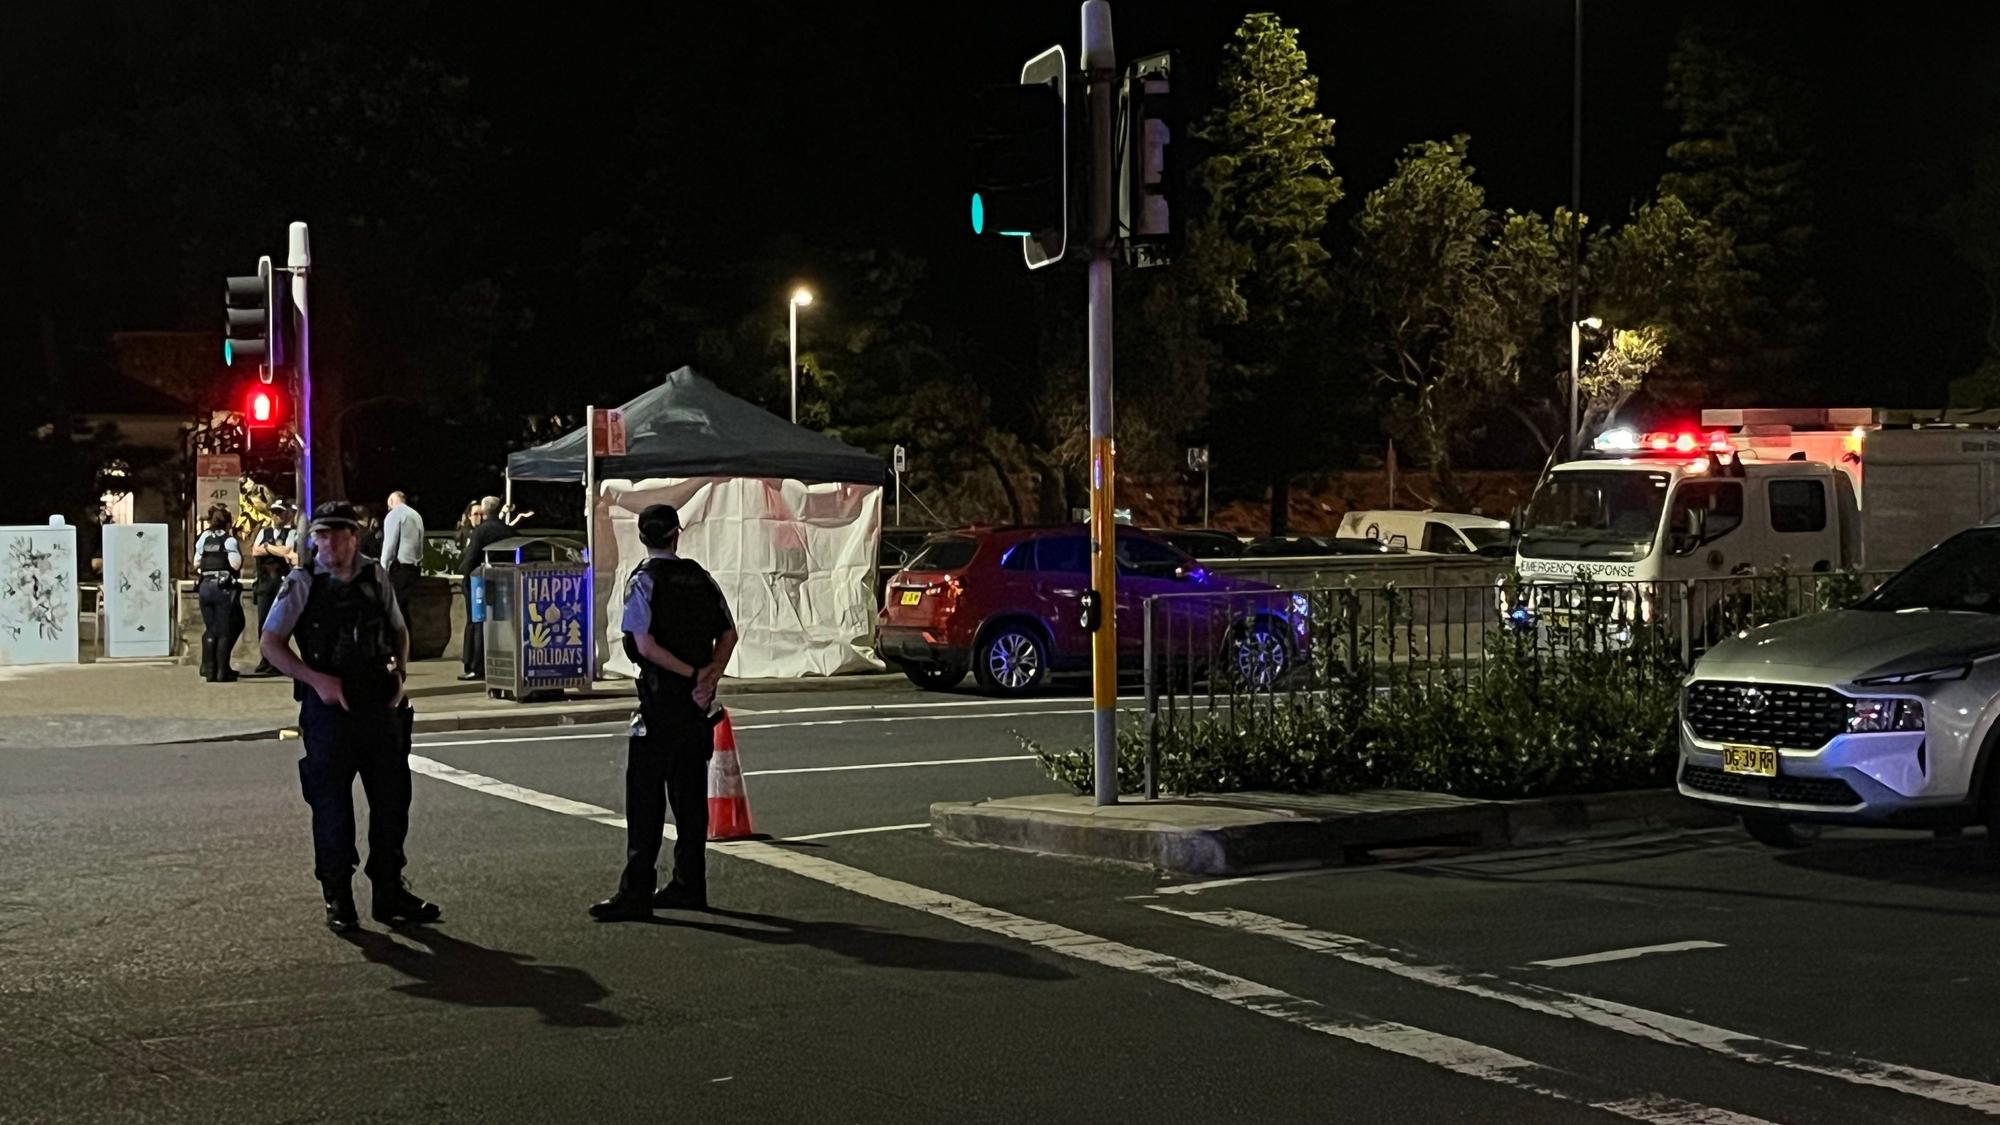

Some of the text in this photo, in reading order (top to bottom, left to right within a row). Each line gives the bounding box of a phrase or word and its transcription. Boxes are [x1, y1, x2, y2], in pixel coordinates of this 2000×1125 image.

[210, 489, 228, 499] 4P
[1520, 561, 1575, 574] EMERGENCY
[528, 577, 581, 601] HAPPY
[528, 648, 583, 666] HOLIDAYS
